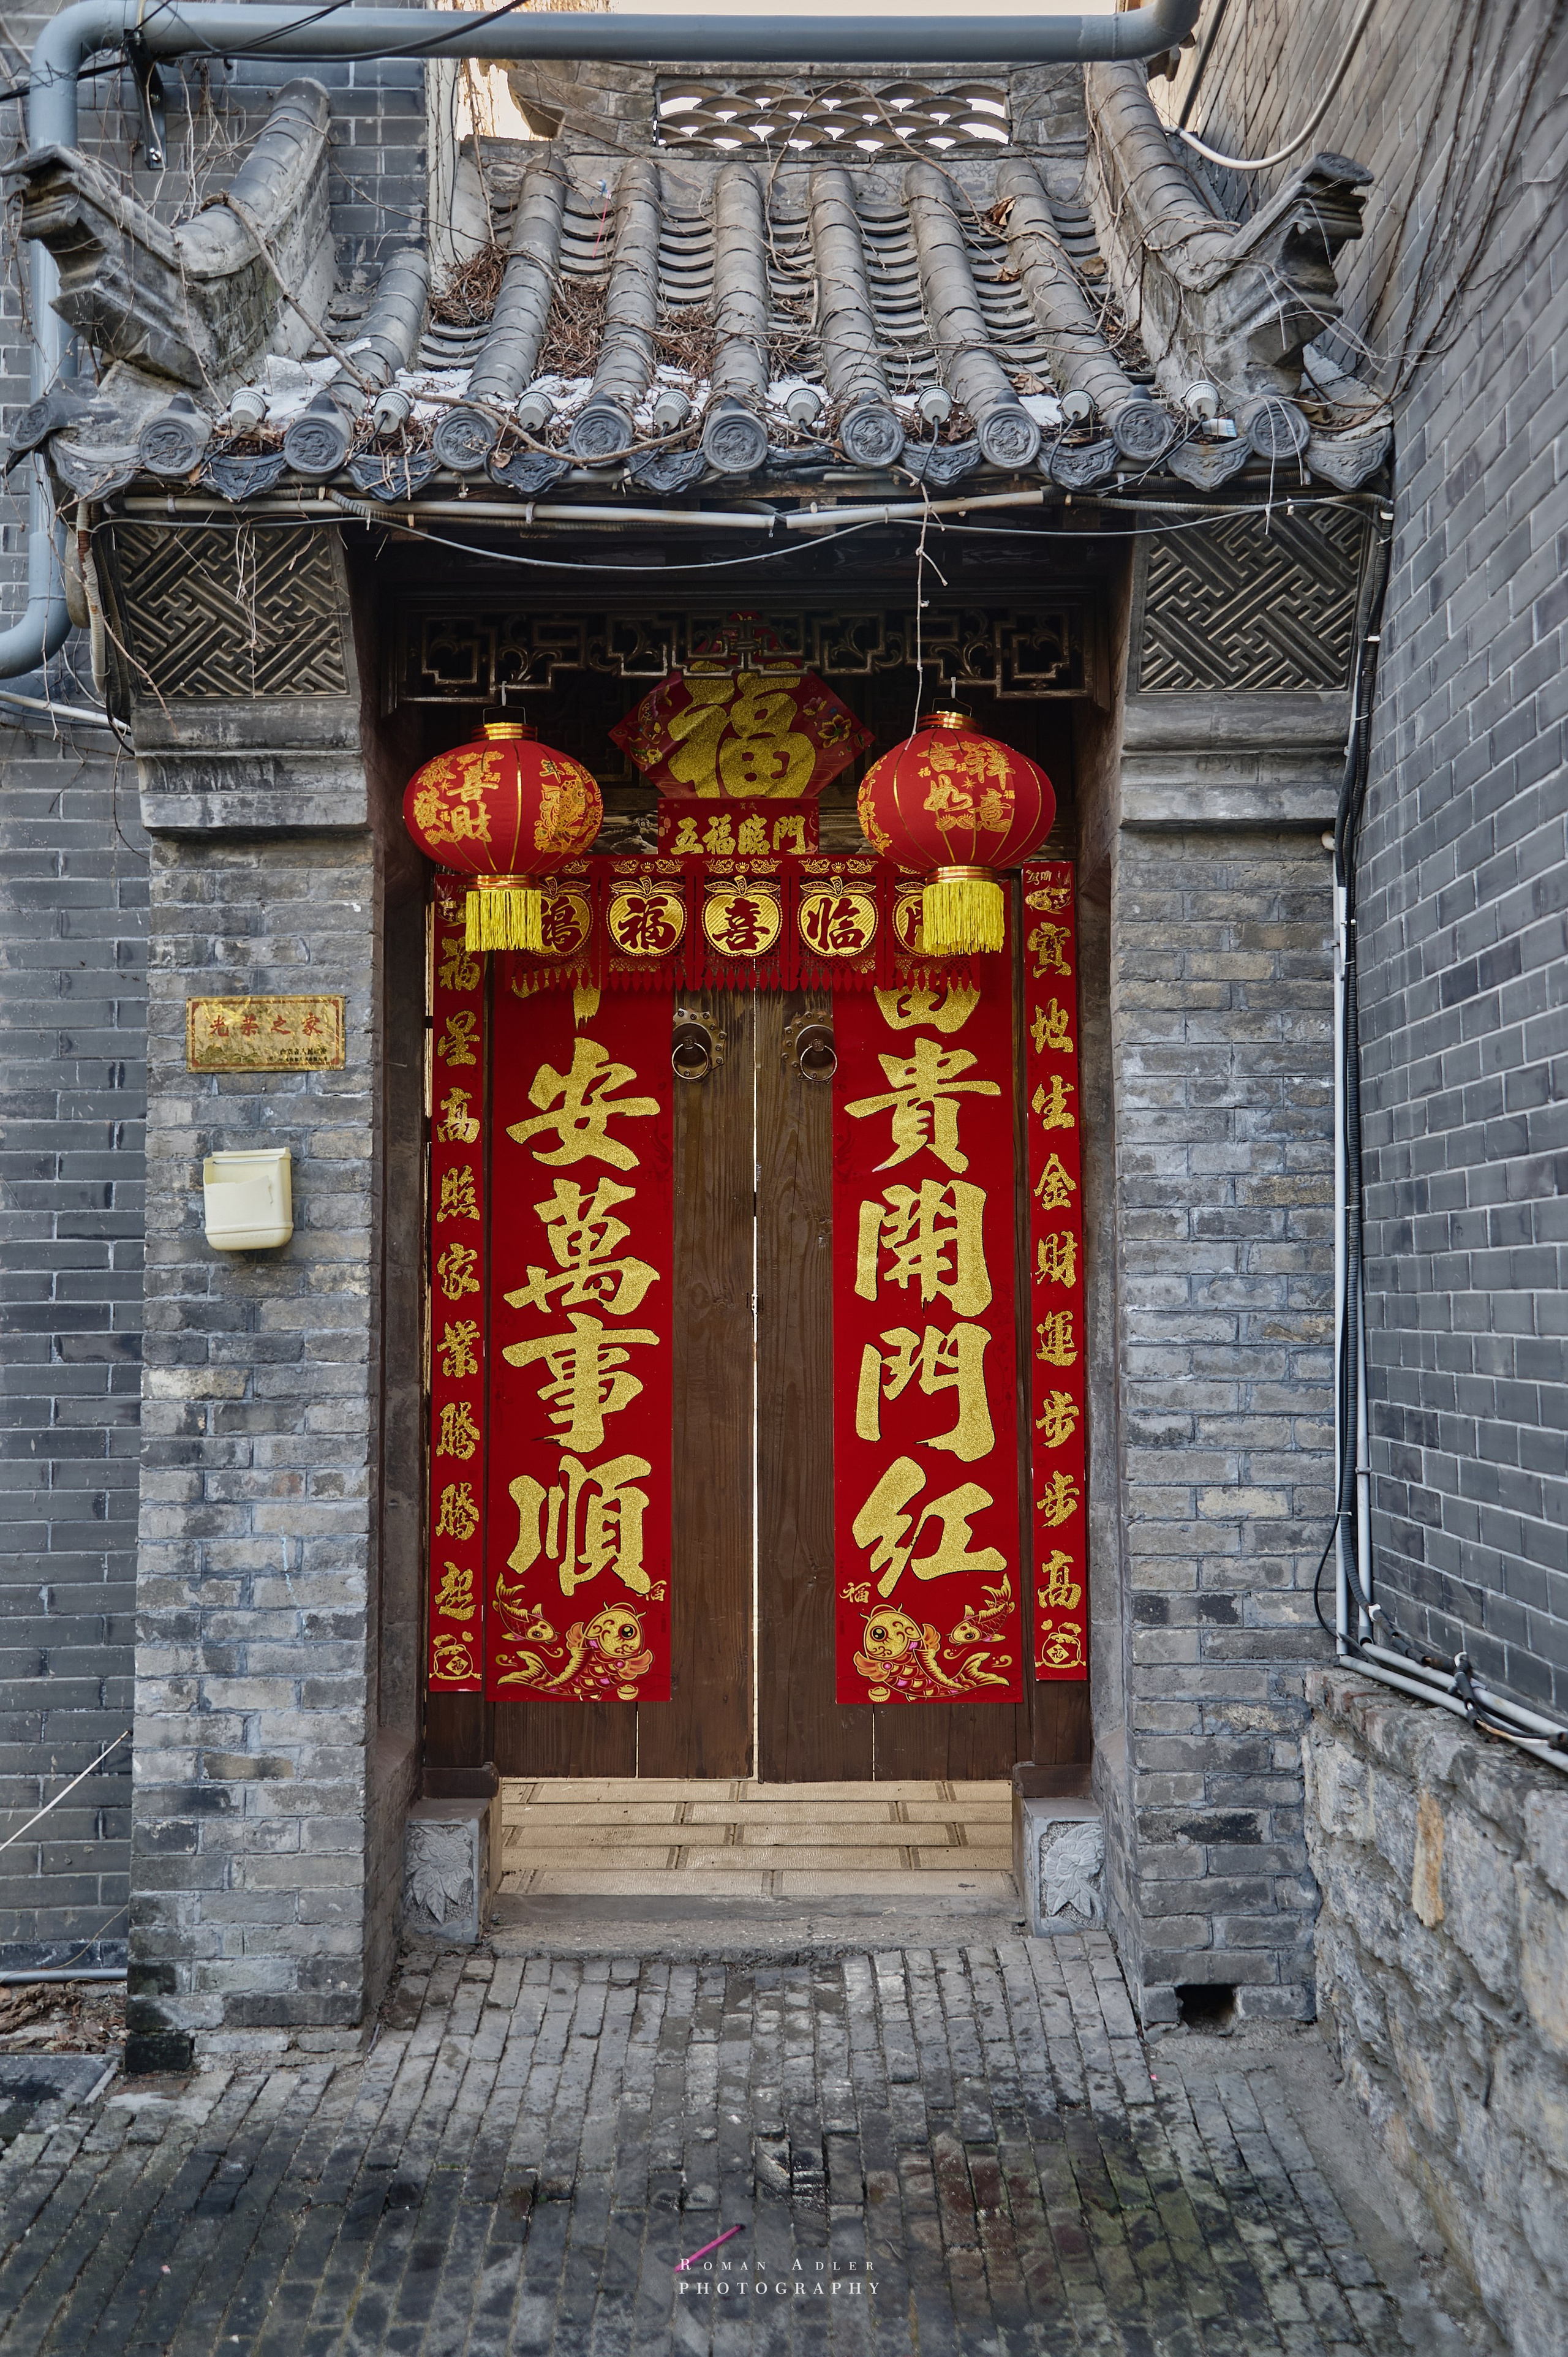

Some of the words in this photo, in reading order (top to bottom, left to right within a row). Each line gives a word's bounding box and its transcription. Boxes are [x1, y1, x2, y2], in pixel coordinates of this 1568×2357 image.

[668, 661, 816, 798] 福
[918, 742, 1016, 790] 吉祥
[924, 774, 1012, 832] 如意
[670, 813, 806, 855] 五福臨門
[210, 1013, 323, 1037] 光荣之家
[839, 1582, 871, 1603] 福
[451, 1659, 464, 1670] 福
[1052, 1648, 1063, 1659] 福
